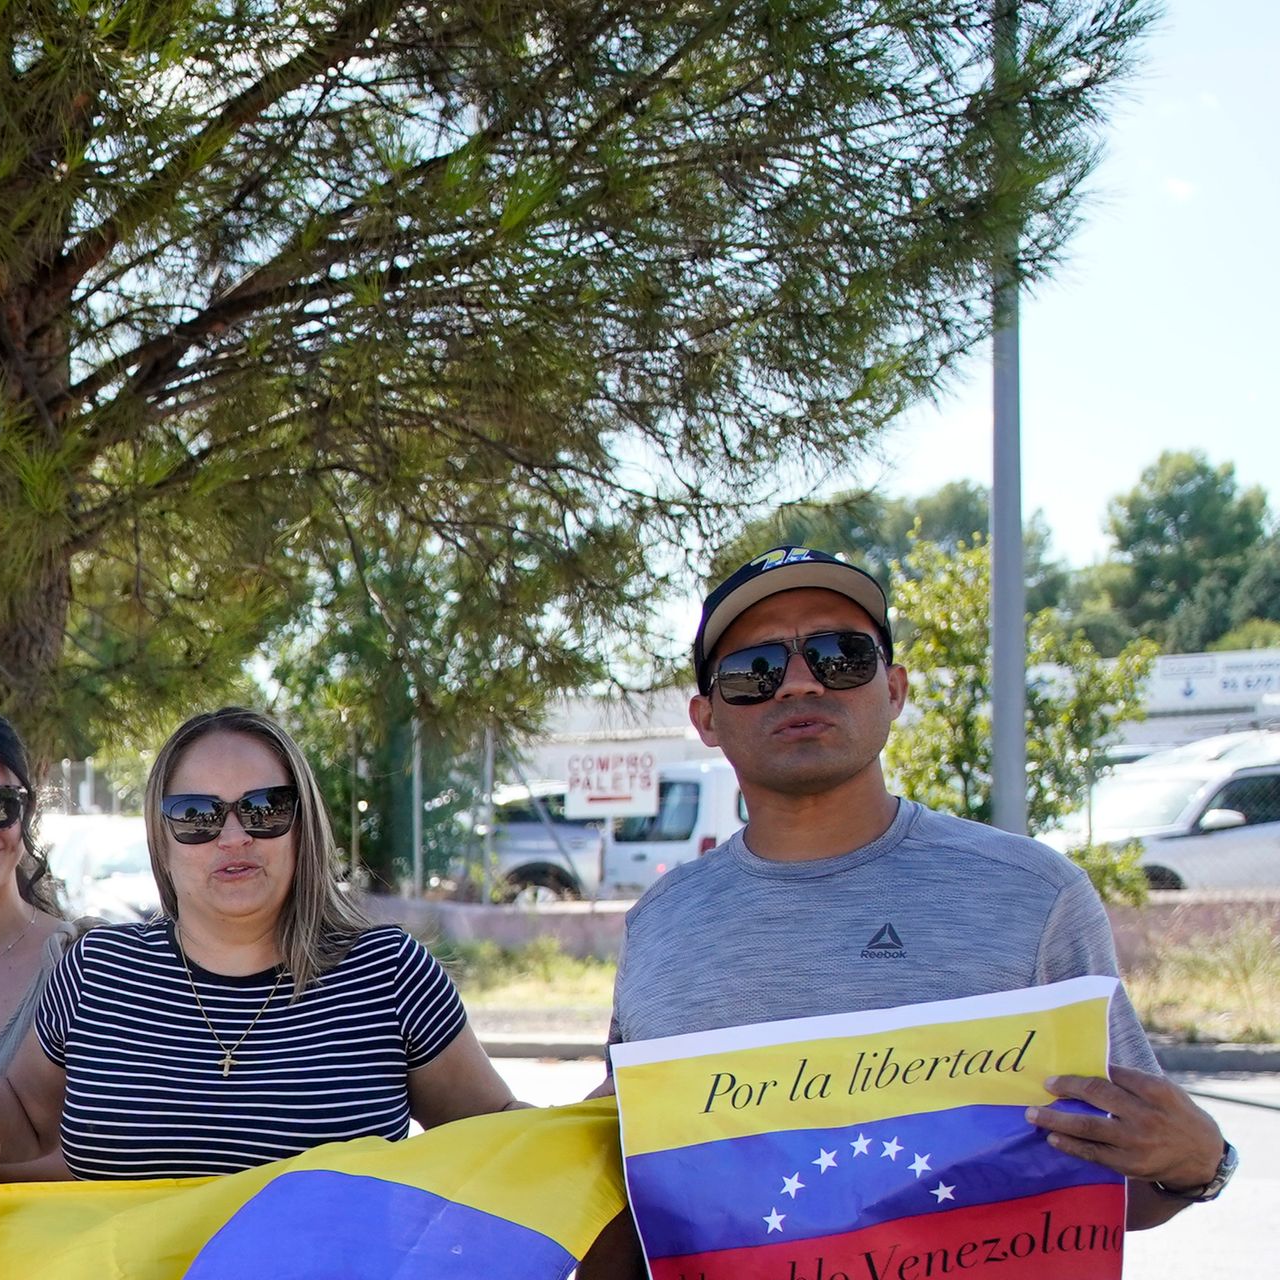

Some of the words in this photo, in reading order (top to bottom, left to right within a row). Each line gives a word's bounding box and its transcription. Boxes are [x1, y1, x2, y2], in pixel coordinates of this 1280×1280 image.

[568, 752, 653, 773] COMPRO
[568, 774, 652, 792] PALETS
[860, 950, 907, 959] Reebok
[698, 1072, 778, 1115] Por
[789, 1059, 831, 1102] la
[847, 1029, 1037, 1096] libertad
